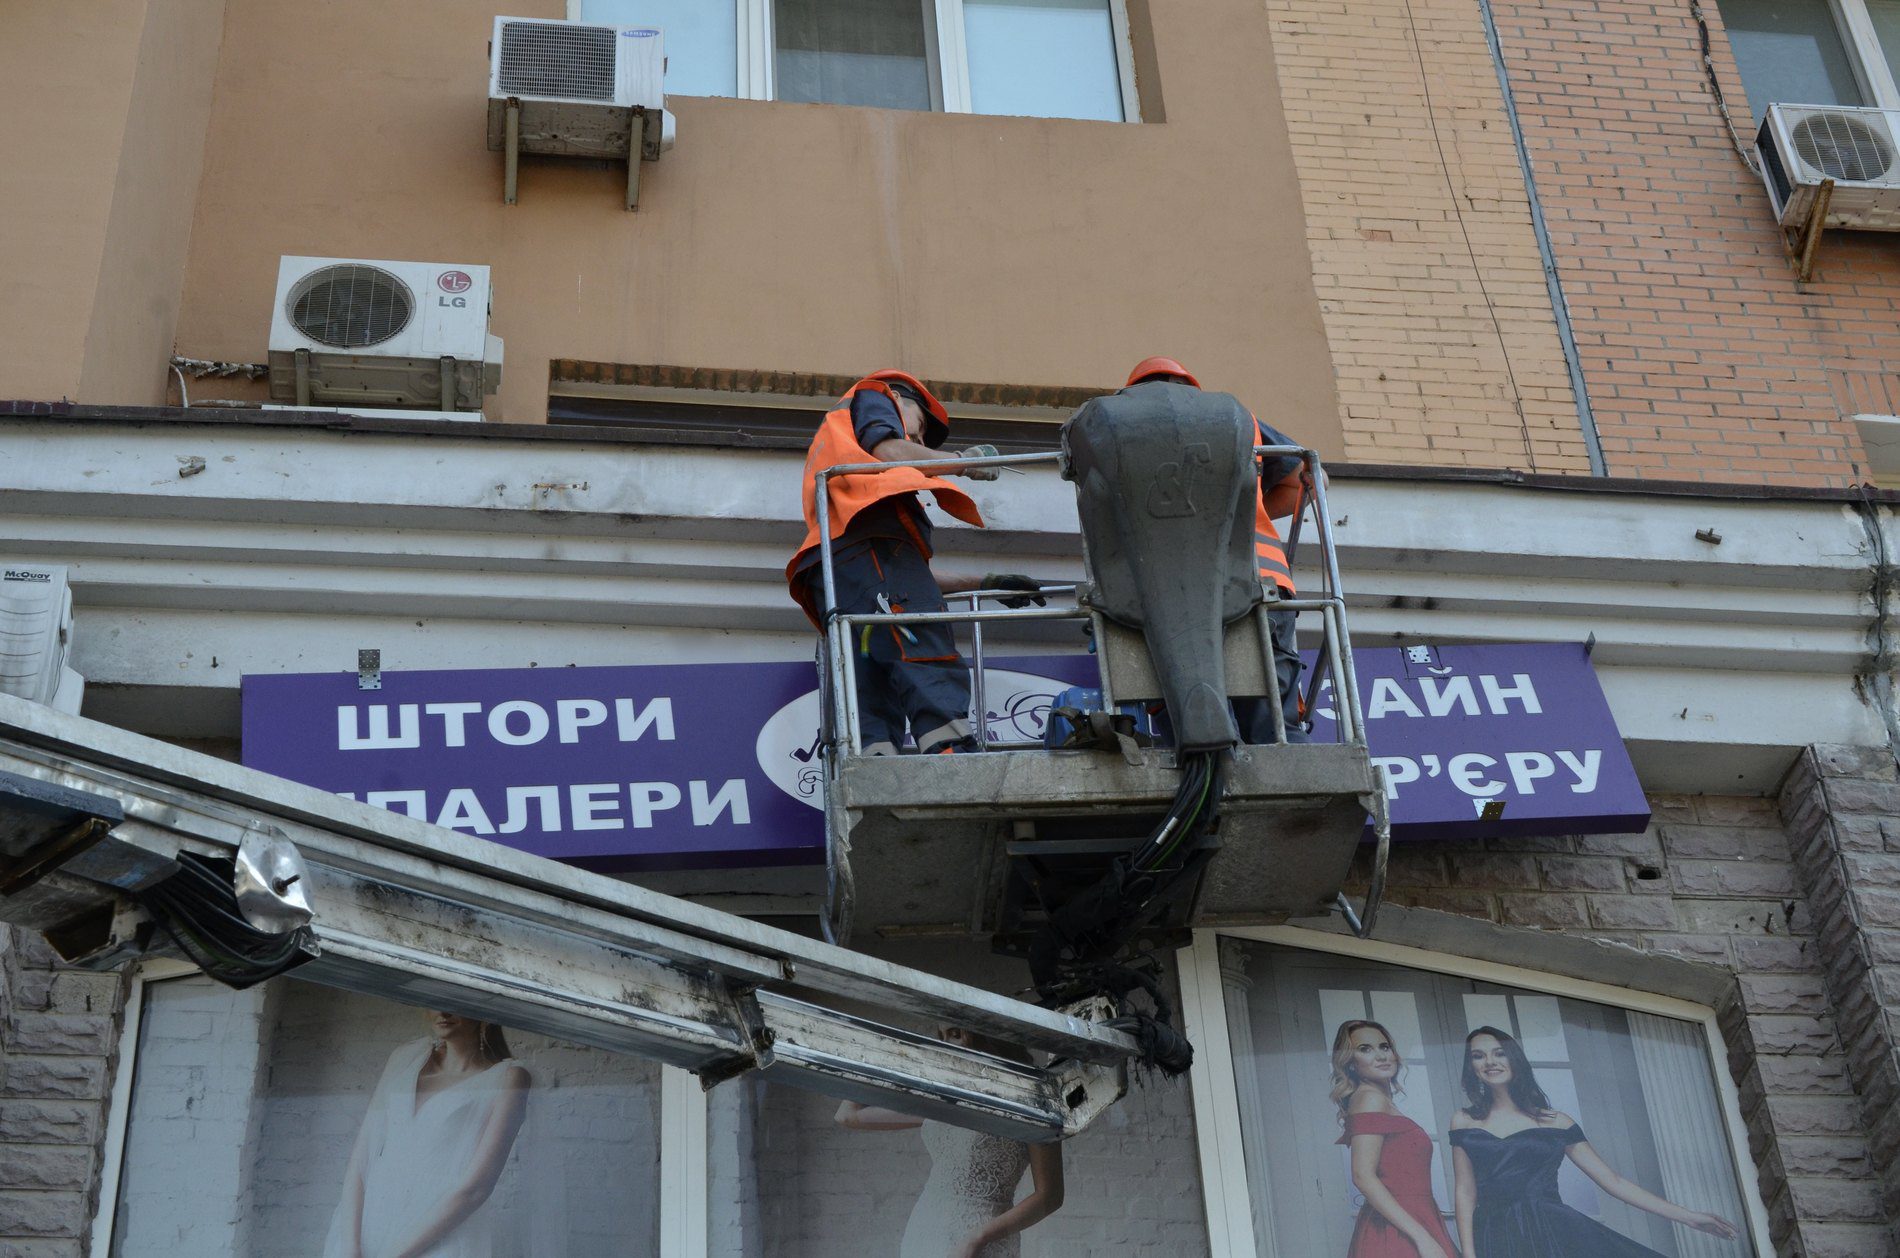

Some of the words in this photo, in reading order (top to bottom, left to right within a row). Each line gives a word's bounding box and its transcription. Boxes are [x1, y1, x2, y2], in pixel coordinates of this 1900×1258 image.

[439, 296, 466, 308] LG
[4, 571, 51, 580] McQuay
[338, 697, 676, 751] ШТОРИ
[1370, 749, 1603, 800] Р’ЄРУ
[336, 778, 751, 835] ПАЛЕРИ
